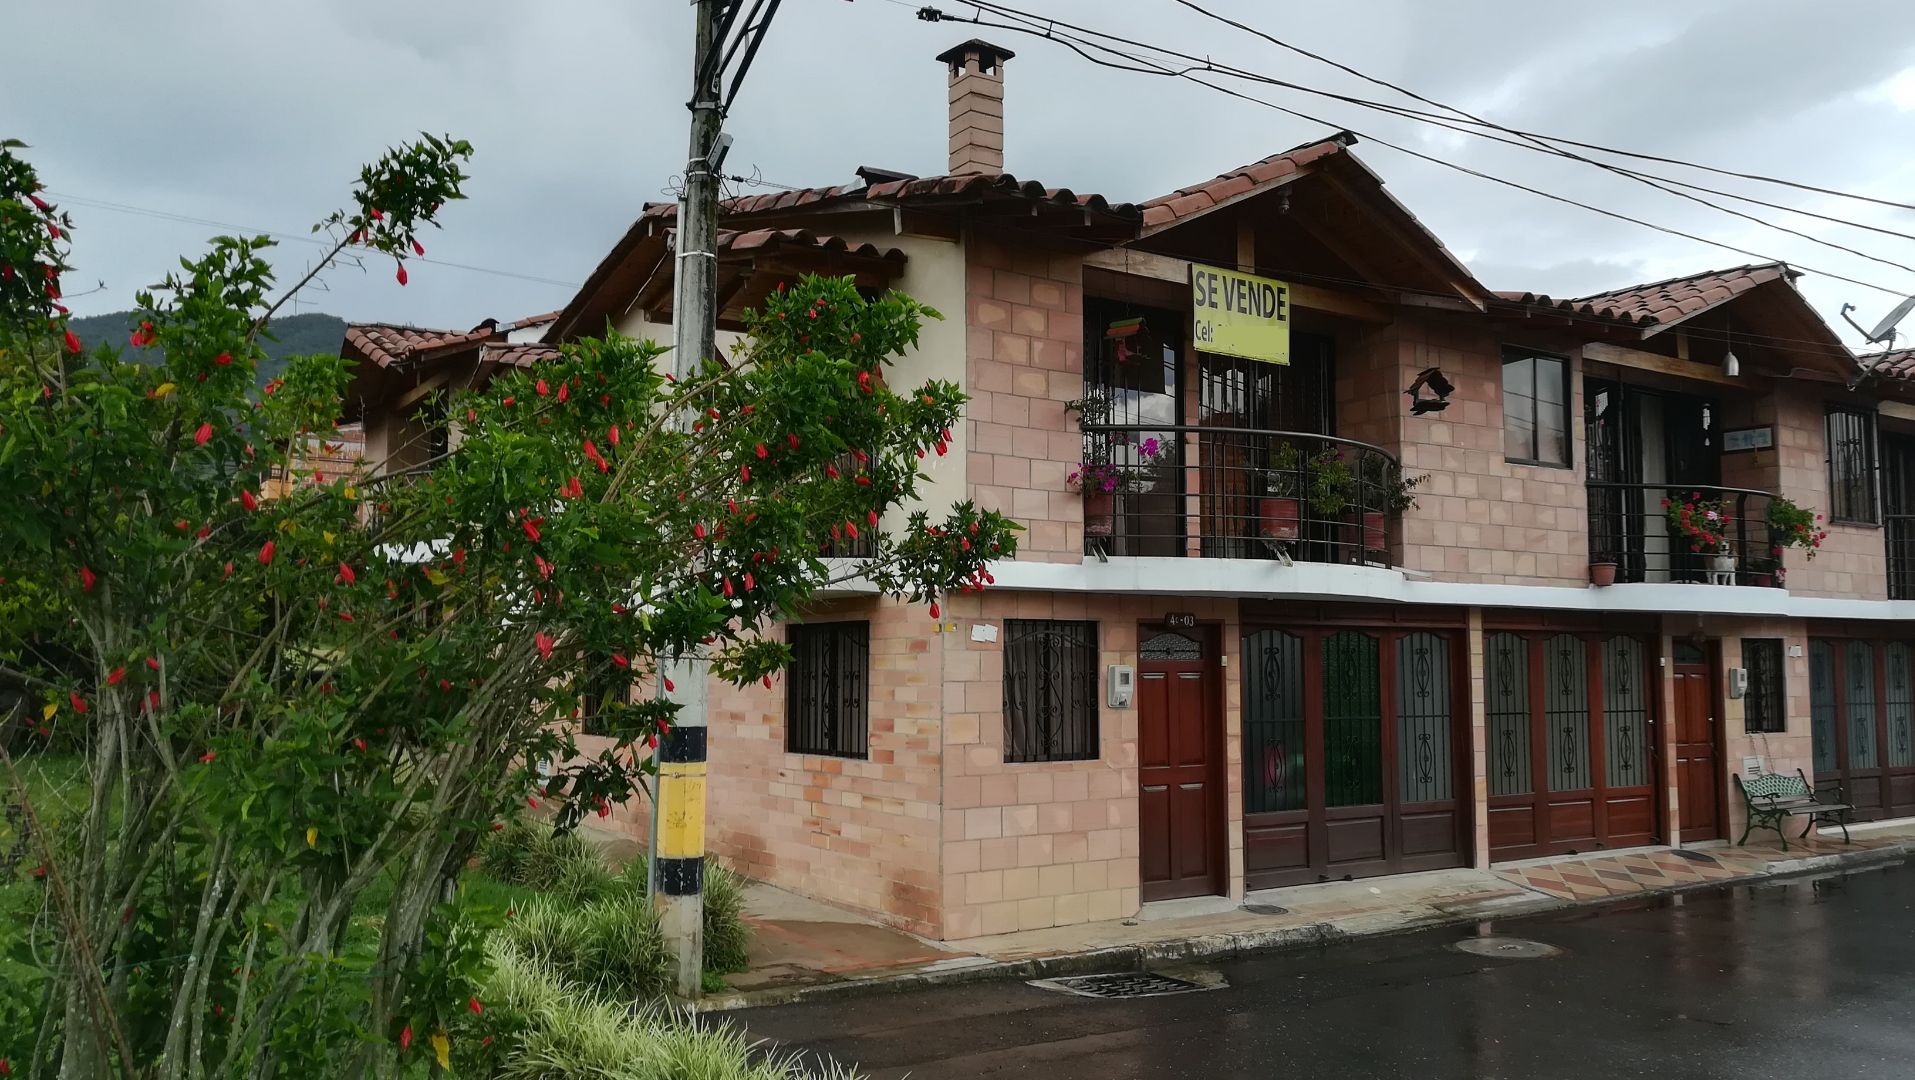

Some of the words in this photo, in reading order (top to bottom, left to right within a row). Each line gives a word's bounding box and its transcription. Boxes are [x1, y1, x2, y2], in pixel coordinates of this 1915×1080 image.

[1195, 270, 1218, 309] SE
[1222, 275, 1287, 322] VENDE
[1195, 319, 1213, 343] Cel:
